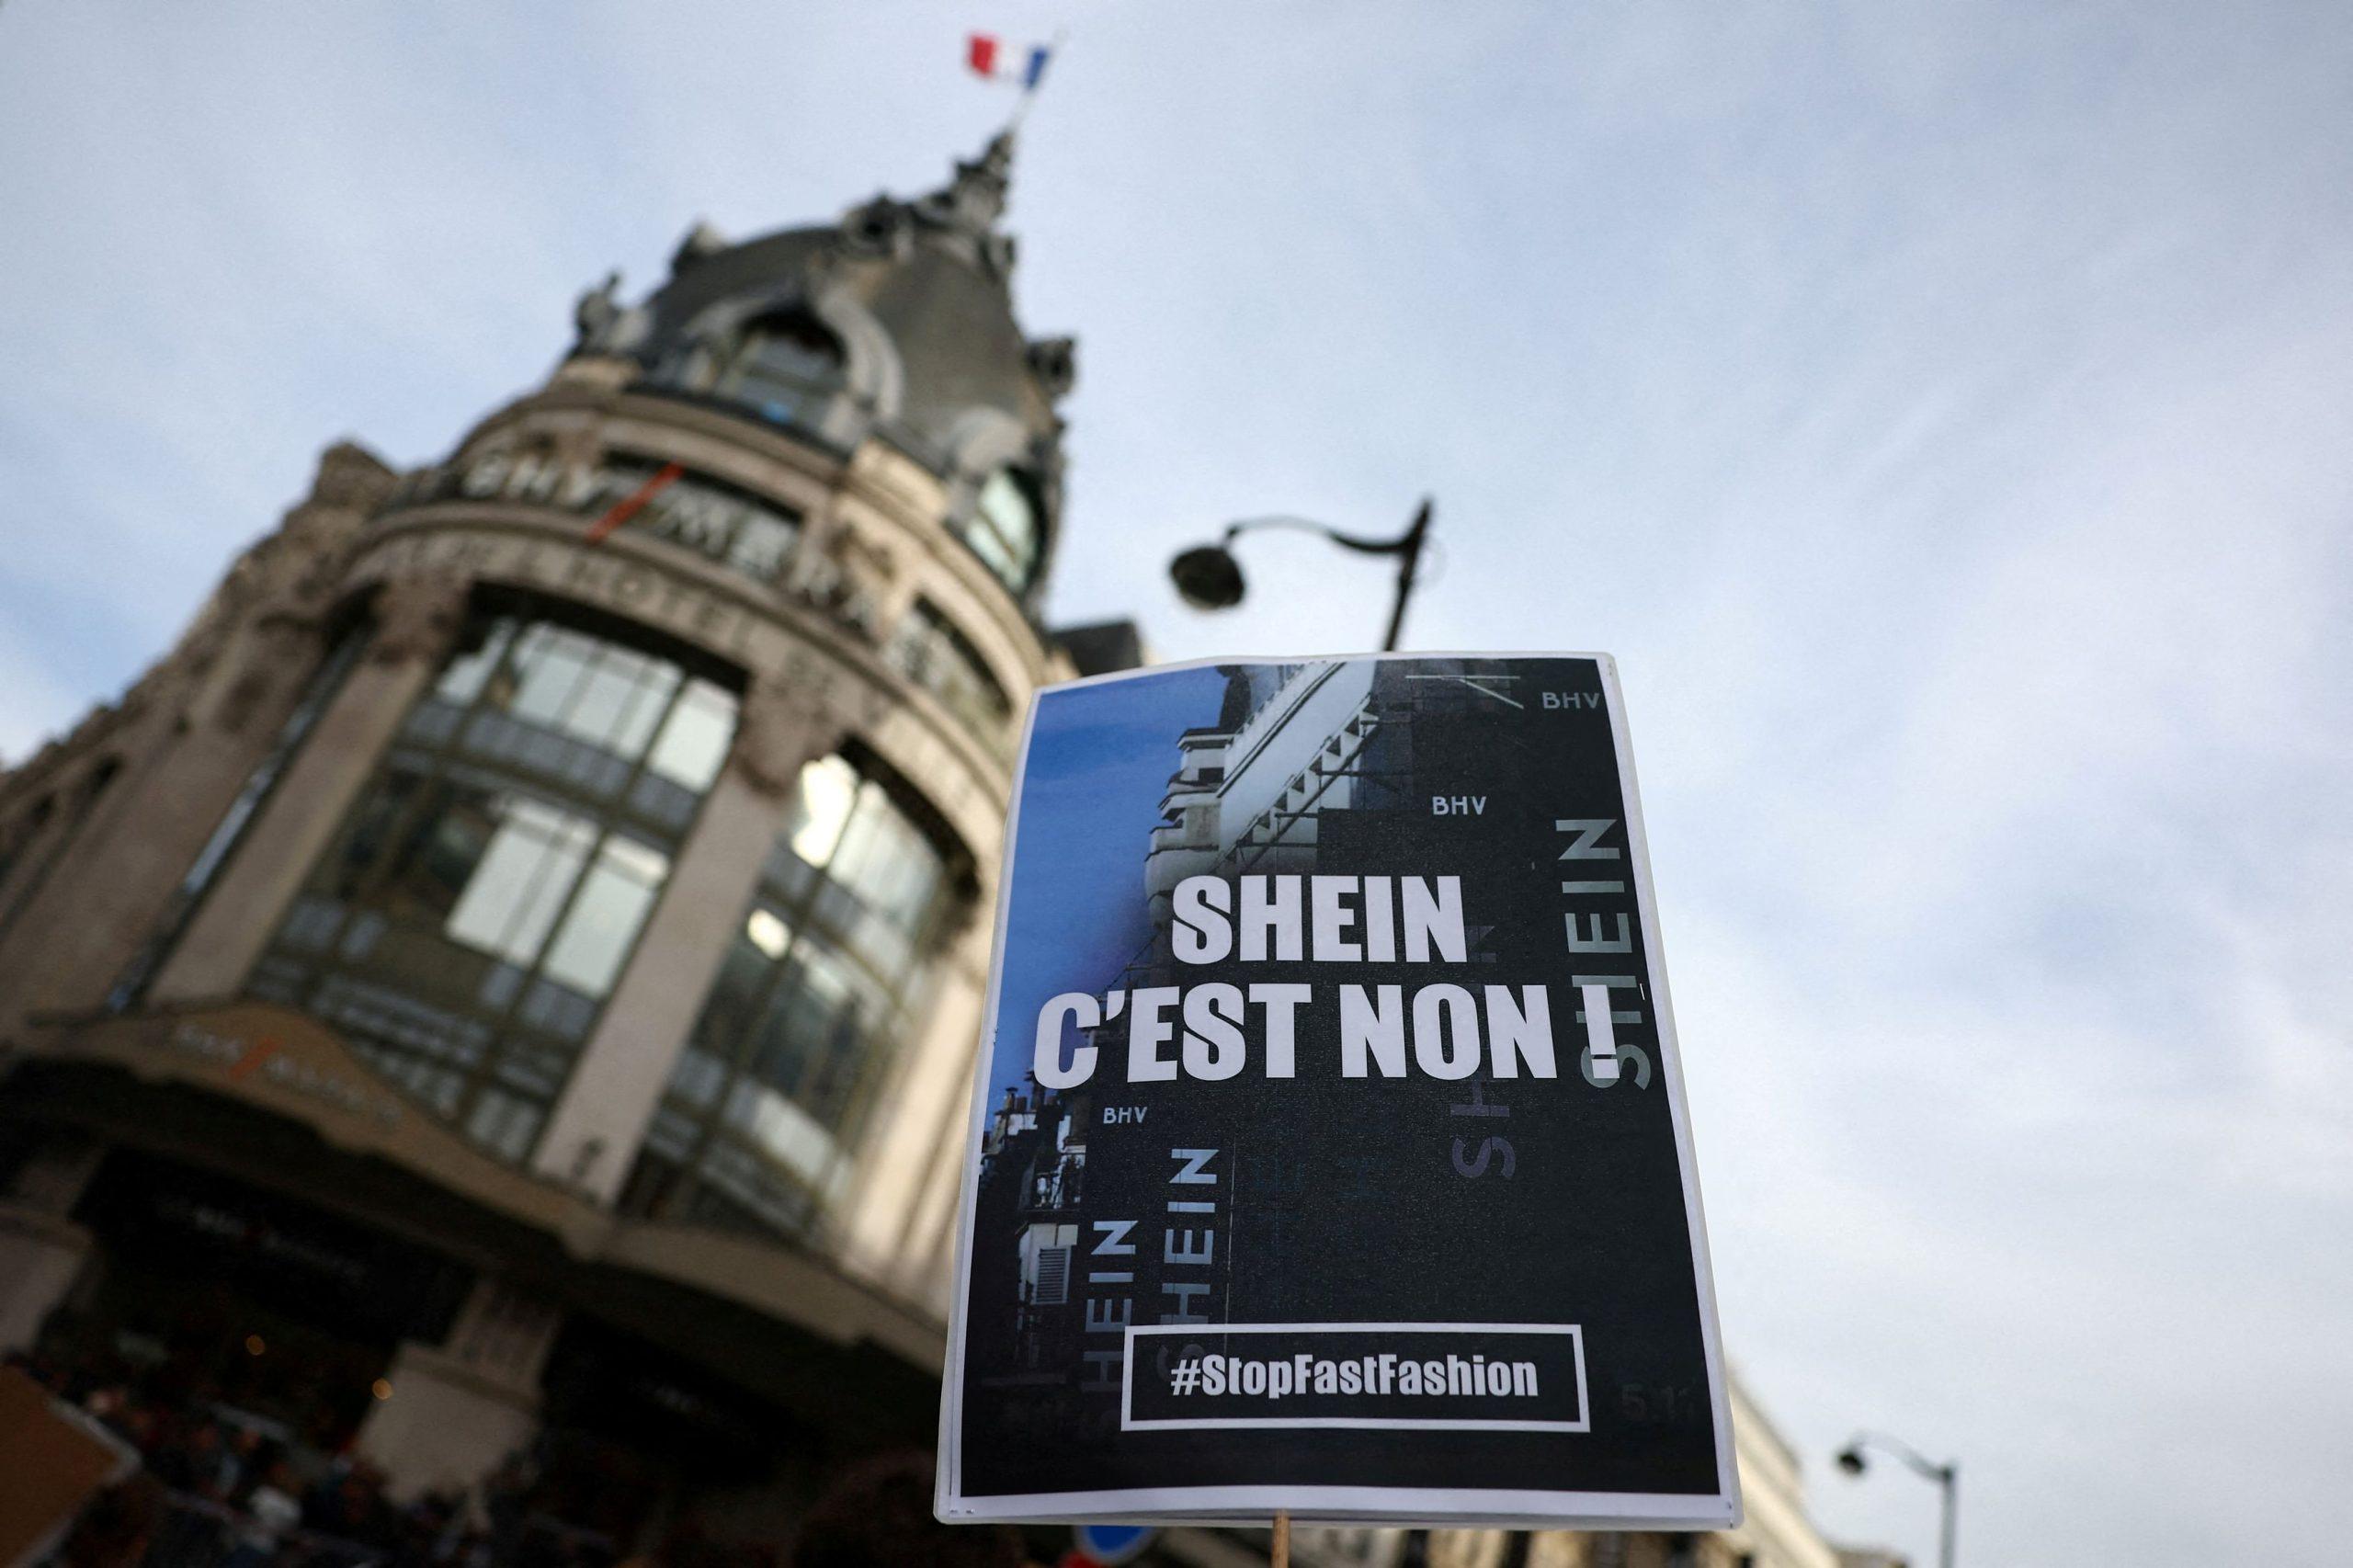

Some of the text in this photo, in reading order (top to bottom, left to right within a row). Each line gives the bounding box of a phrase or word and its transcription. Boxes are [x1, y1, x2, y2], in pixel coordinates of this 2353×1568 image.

[1542, 692, 1599, 710] BHV
[1432, 796, 1487, 816] BHV
[1173, 875, 1468, 965] SHEIN
[1033, 983, 1620, 1089] C'EST NON !
[1103, 1107, 1147, 1124] BHV
[1081, 1220, 1139, 1392] HEIN
[1170, 1353, 1539, 1400] #StopFastFashion
